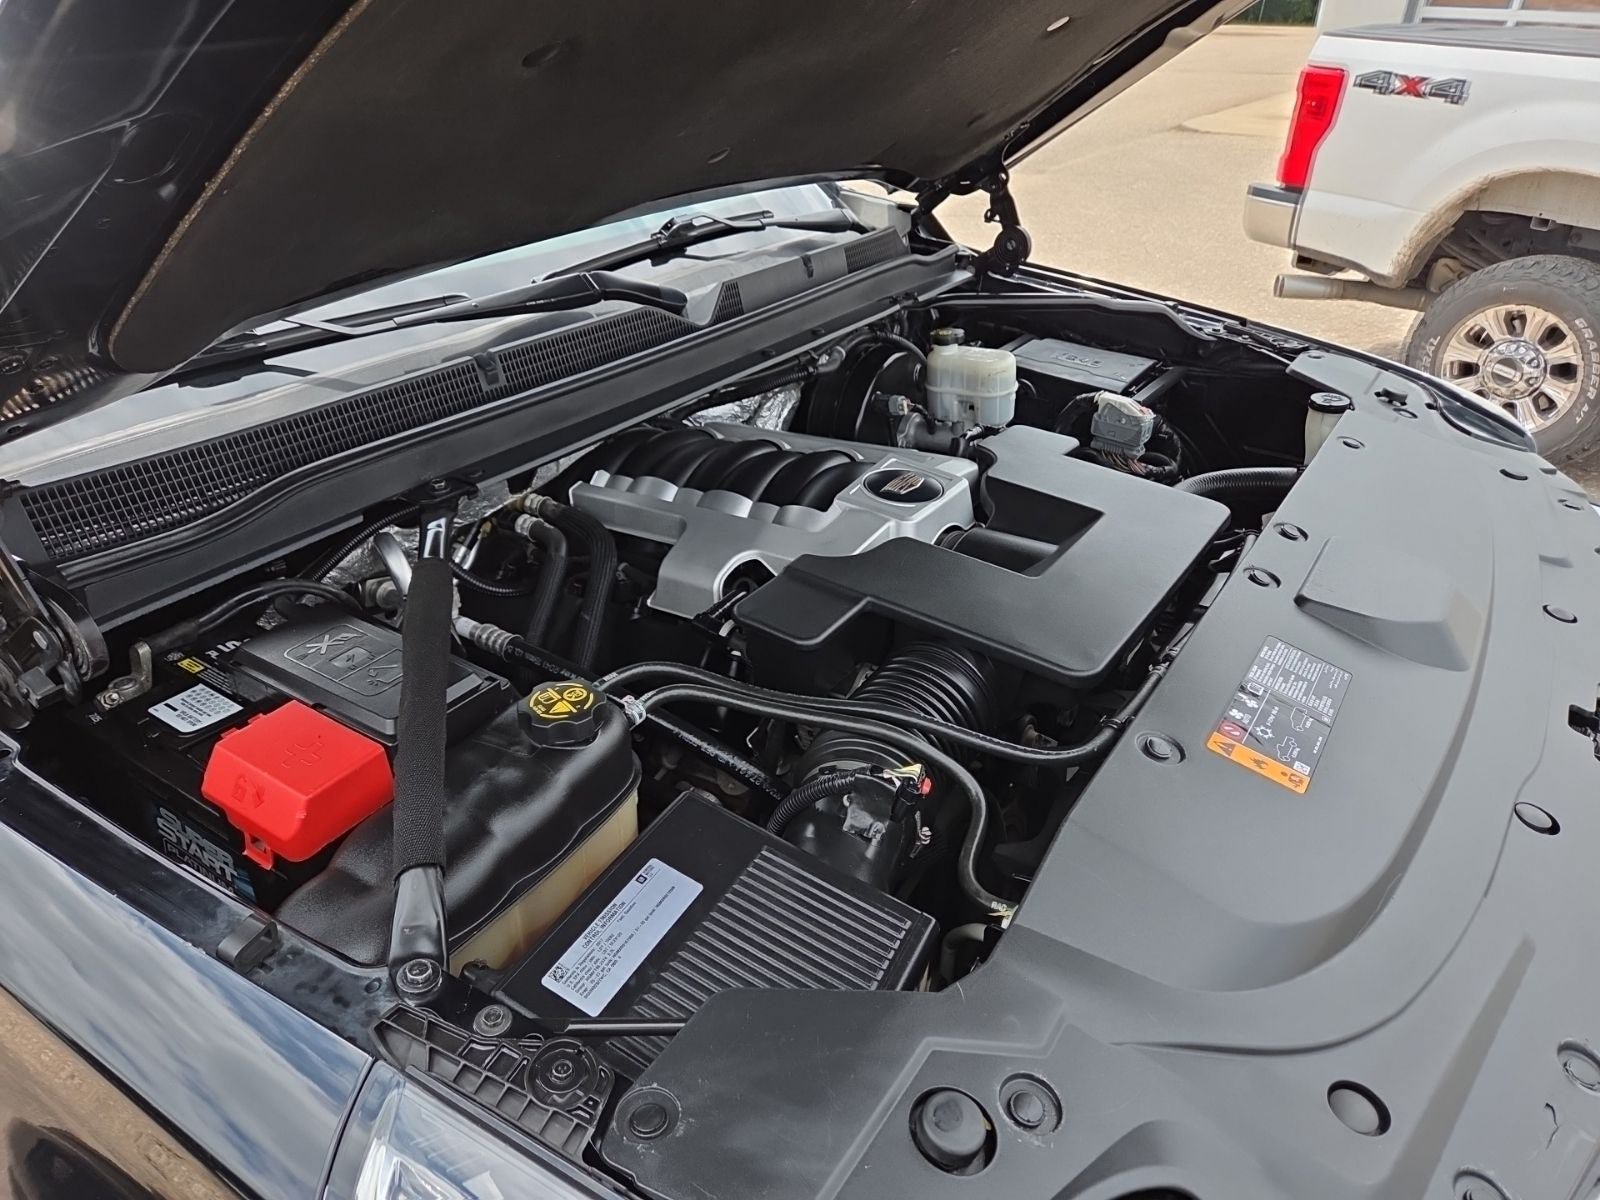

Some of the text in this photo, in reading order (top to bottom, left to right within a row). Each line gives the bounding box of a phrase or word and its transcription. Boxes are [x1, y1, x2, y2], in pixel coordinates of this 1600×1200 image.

[1574, 317, 1600, 400] GRABBER
[156, 816, 238, 882] START
[159, 806, 235, 873] SUPER
[581, 901, 626, 949] CONTROL INFORMATION
[582, 902, 617, 940] VEHICLE EMISSION
